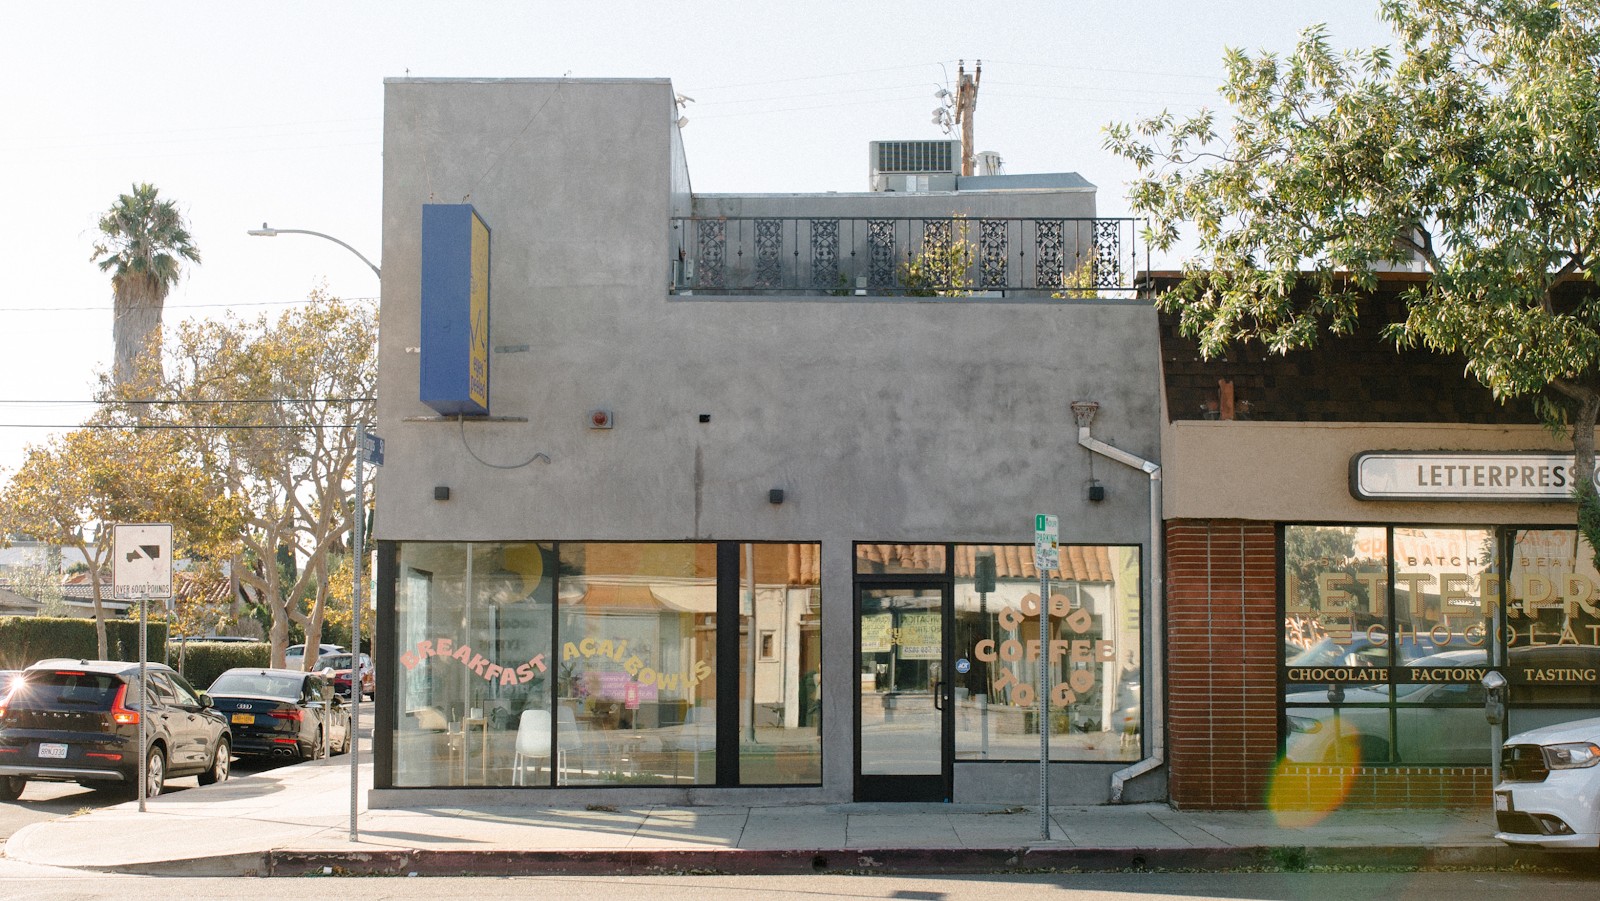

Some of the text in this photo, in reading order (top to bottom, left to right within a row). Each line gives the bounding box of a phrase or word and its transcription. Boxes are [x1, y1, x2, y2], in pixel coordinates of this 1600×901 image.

[1407, 556, 1479, 567] BATCH
[115, 584, 130, 594] OVER
[147, 584, 170, 593] POUNDS
[998, 592, 1092, 634] GOOD
[400, 638, 548, 686] BREAKFAST
[974, 639, 1116, 662] COFFEE
[623, 655, 712, 691] BOWLS
[993, 667, 1095, 707] TO GO
[1287, 668, 1597, 681] CHOCOLATE FACTORY TASTING
